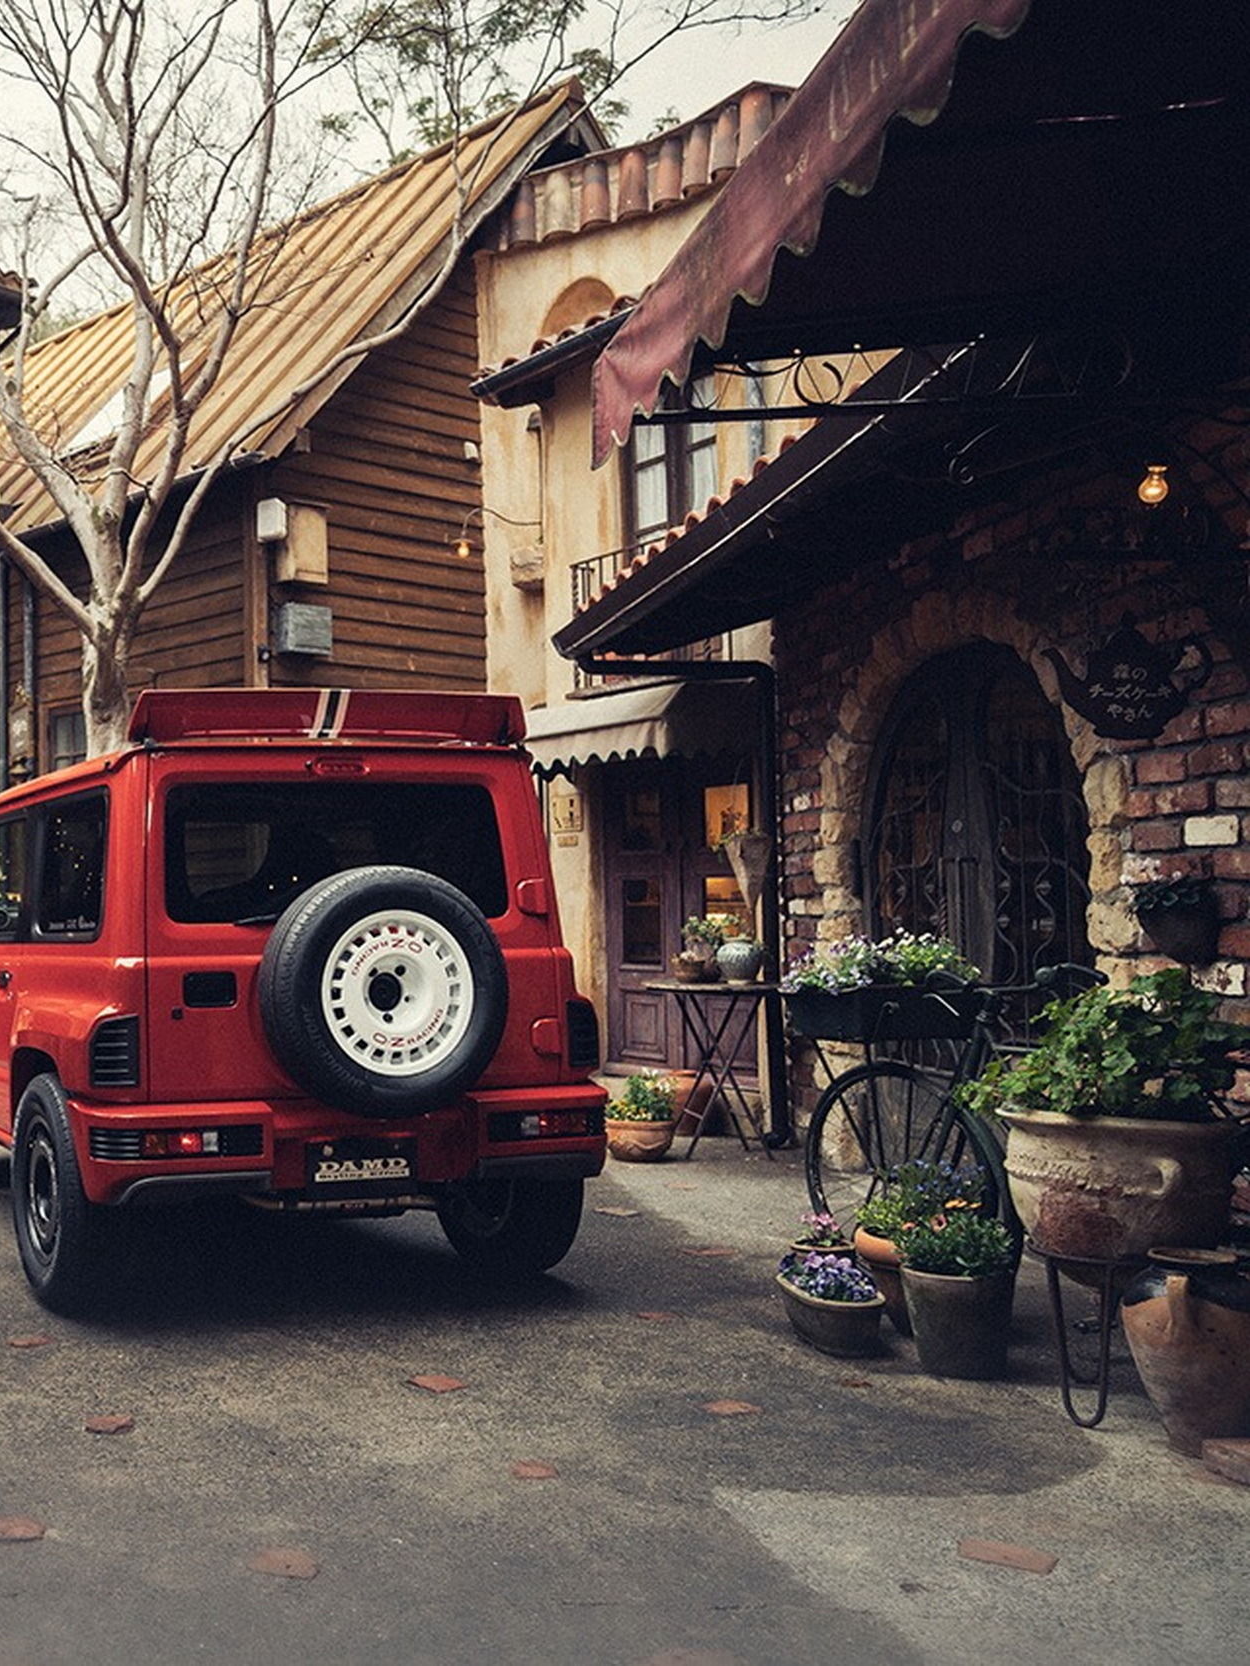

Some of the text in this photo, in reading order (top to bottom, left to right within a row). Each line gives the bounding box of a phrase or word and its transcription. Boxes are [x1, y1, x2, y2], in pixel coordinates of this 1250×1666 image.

[1107, 704, 1154, 722] やさん
[406, 1008, 444, 1045] RACING
[318, 1158, 408, 1173] DAMD
